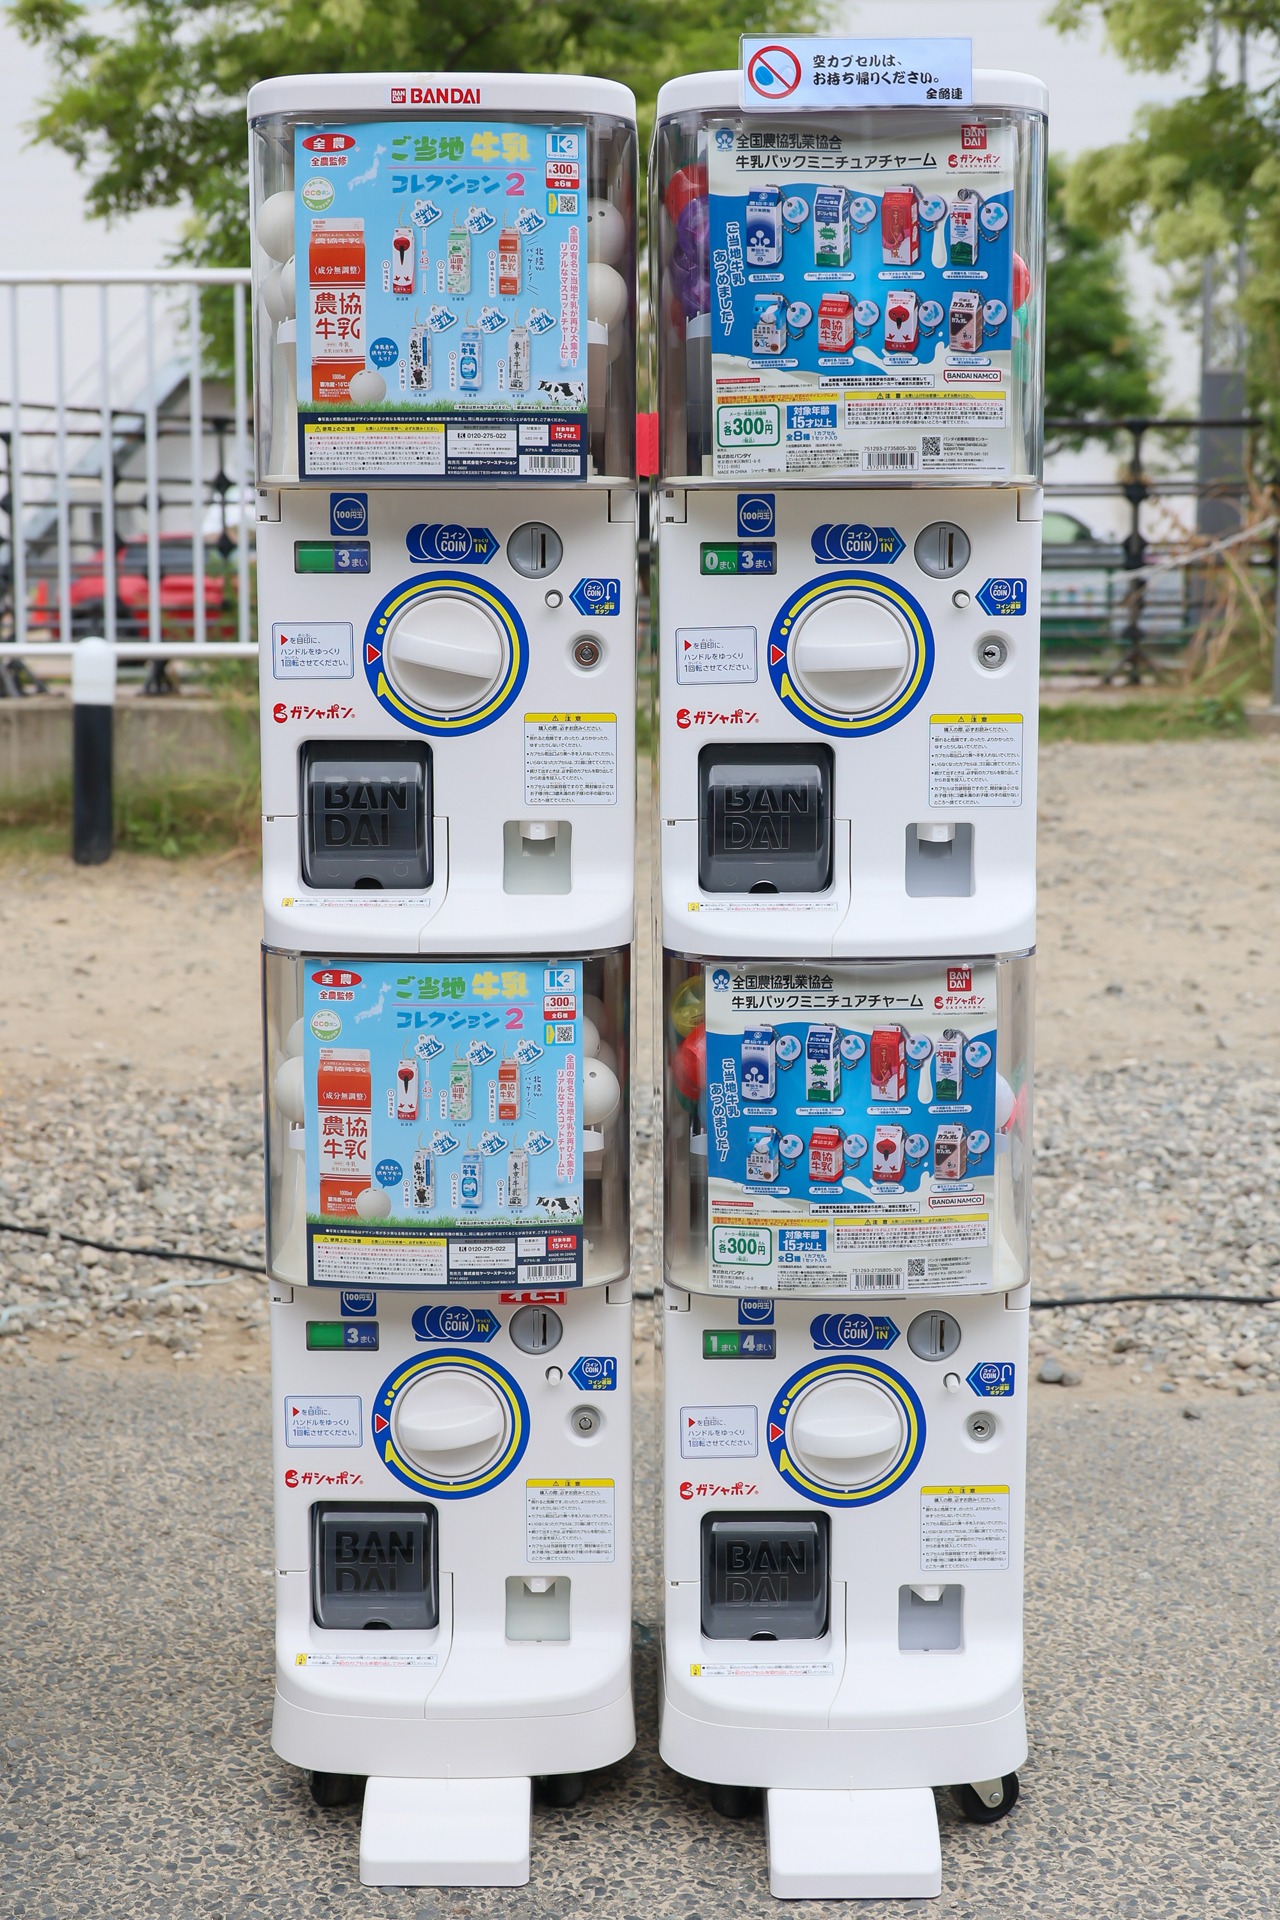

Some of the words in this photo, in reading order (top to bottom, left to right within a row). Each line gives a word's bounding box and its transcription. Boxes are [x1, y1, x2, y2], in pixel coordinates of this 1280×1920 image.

[813, 55, 902, 69] 空カプセルは、
[813, 71, 940, 85] お持ち帰りください。
[411, 88, 480, 104] BANDAI
[926, 88, 963, 100] 全酪連
[963, 128, 985, 137] BAN
[313, 137, 345, 150] 全農
[736, 133, 843, 149] 全国農協乳業協会
[963, 137, 981, 146] DAI
[311, 156, 347, 167] 全農監修
[736, 153, 937, 169] 牛乳パックミニチュアチャーム
[727, 222, 745, 286] ご当地牛乳
[714, 250, 734, 336] あつめました!
[314, 292, 362, 315] 農協
[315, 317, 361, 340] 牛乳
[820, 319, 843, 330] 農協
[820, 331, 843, 342] 牛乳
[793, 406, 830, 415] 対象年齢
[723, 417, 773, 435] 各300円
[791, 416, 832, 428] 15才以上
[786, 431, 810, 441] 全8種
[336, 511, 363, 519] 100円玉
[743, 512, 770, 520] 100円玉
[441, 541, 466, 552] COIN
[475, 544, 487, 553] IN
[846, 541, 872, 552] COIN
[880, 542, 893, 552] IN
[338, 550, 368, 567] 3まい
[705, 552, 736, 570] 0まい
[741, 550, 772, 569] 3まい
[281, 659, 349, 667] 1回転させてください。
[684, 664, 752, 672] 1回転させてください。
[325, 813, 389, 846] DAI
[724, 816, 790, 850] DAI
[321, 973, 352, 985] 全農
[732, 974, 834, 990] 全国農協乳業協会
[949, 980, 966, 988] DAI
[320, 991, 354, 1000] 全農監修
[732, 994, 924, 1009] 牛乳パックミニチュアチャーム
[722, 1059, 740, 1117] ご当地牛乳
[322, 1115, 368, 1137] 農協
[710, 1083, 729, 1162] あつめました!
[323, 1139, 367, 1160] 牛乳
[810, 1151, 833, 1162] 農協
[810, 1162, 832, 1173] 牛乳
[785, 1231, 820, 1240] 対象年齢
[718, 1238, 766, 1255] 各300円
[783, 1240, 822, 1250] 15才以上
[445, 1321, 469, 1331] COIN
[477, 1324, 489, 1332] IN
[347, 1327, 376, 1343] 3まい
[843, 1328, 868, 1339] COIN
[876, 1330, 888, 1339] IN
[710, 1336, 737, 1352] 1まい
[742, 1335, 772, 1352] 4まい
[293, 1429, 358, 1437] 1回転させてください。
[688, 1439, 753, 1447] 1回転させてください。
[335, 1531, 414, 1564] BAN
[725, 1540, 807, 1574] BAN
[335, 1567, 398, 1596] DAI
[725, 1577, 788, 1607] DAI
